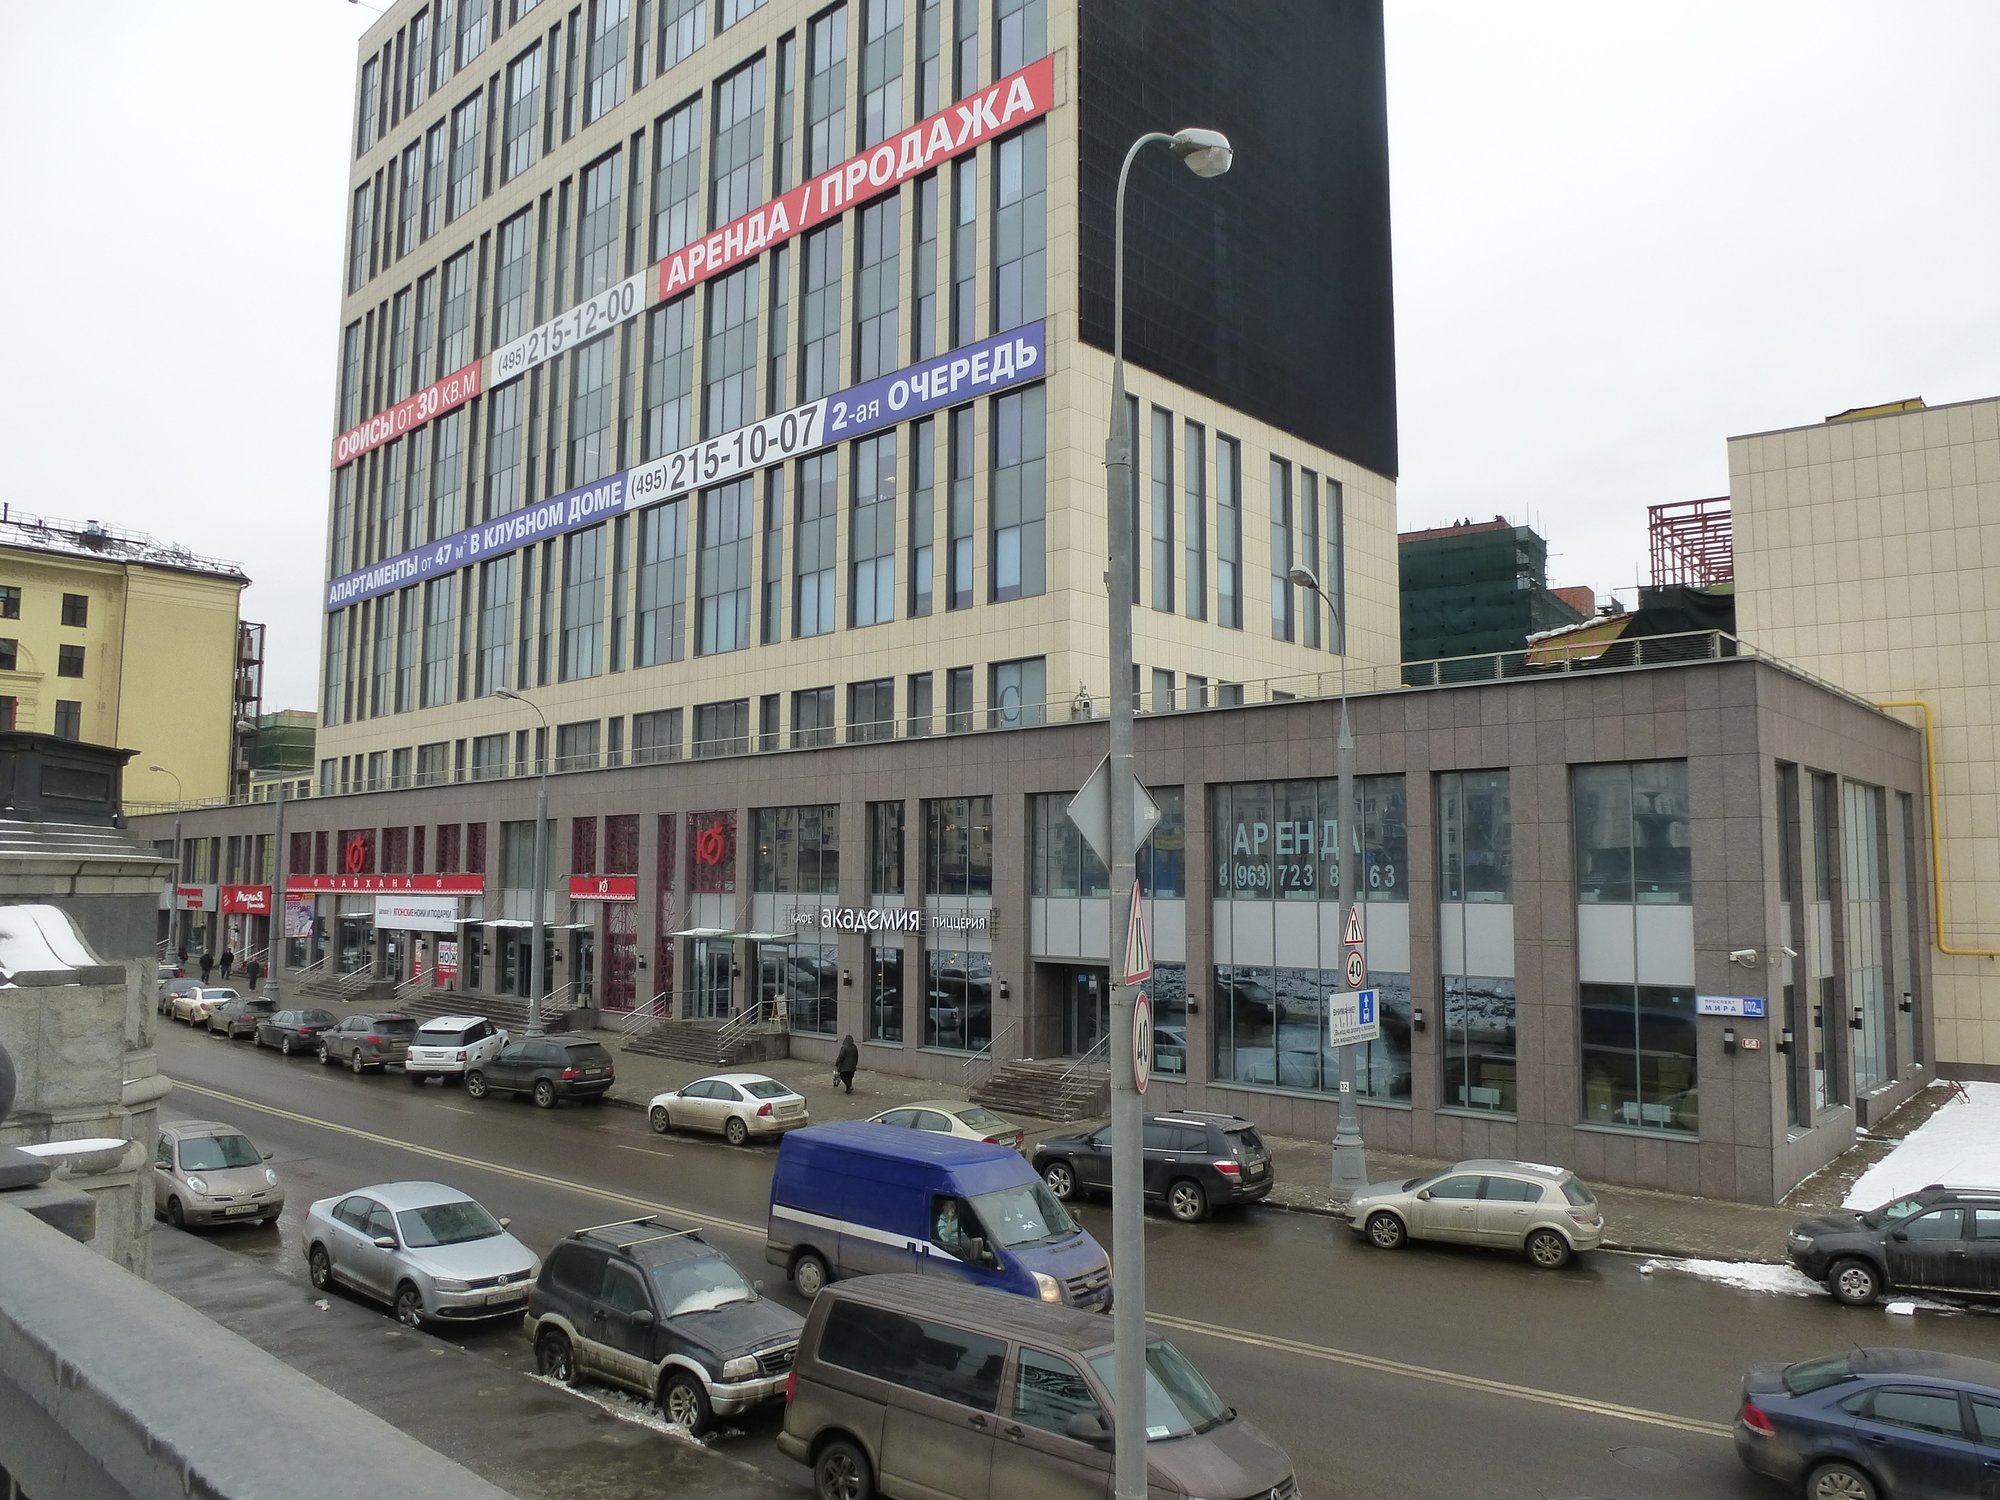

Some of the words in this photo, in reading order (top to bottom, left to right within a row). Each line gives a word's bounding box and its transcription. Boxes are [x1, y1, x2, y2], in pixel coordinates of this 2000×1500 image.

[666, 201, 790, 292] АРЕНДА
[799, 187, 811, 225] /
[821, 76, 1035, 214] ПРОДАЖА
[498, 344, 526, 377] (495)
[528, 282, 634, 364] 215-12-00
[338, 411, 394, 461] ОФИСЫ
[397, 404, 414, 430] ОТ
[417, 387, 438, 420] 30
[442, 371, 475, 407] КВ.М
[831, 399, 880, 431] 2-ая
[887, 337, 1038, 411] ОЧЕРЕДЬ
[630, 464, 668, 501] (495)
[670, 404, 818, 492] 215-10-07
[329, 555, 418, 604] АПАРТАМЕНТЫ
[421, 556, 433, 572] от
[435, 544, 452, 566] 47
[470, 534, 480, 555] В
[484, 507, 563, 550] КЛУБНОМ
[567, 481, 622, 525] ДОМЕ
[330, 877, 412, 888] ЧАЙХАНА
[791, 912, 813, 925] КАФЕ
[821, 908, 920, 933] академия
[932, 916, 985, 930] ПИЦЦЕРИЯ
[1234, 863, 1271, 891] (963)
[1278, 865, 1313, 887] 723
[1369, 865, 1395, 887] 63
[1349, 961, 1361, 978] 40
[1136, 1020, 1149, 1066] 40
